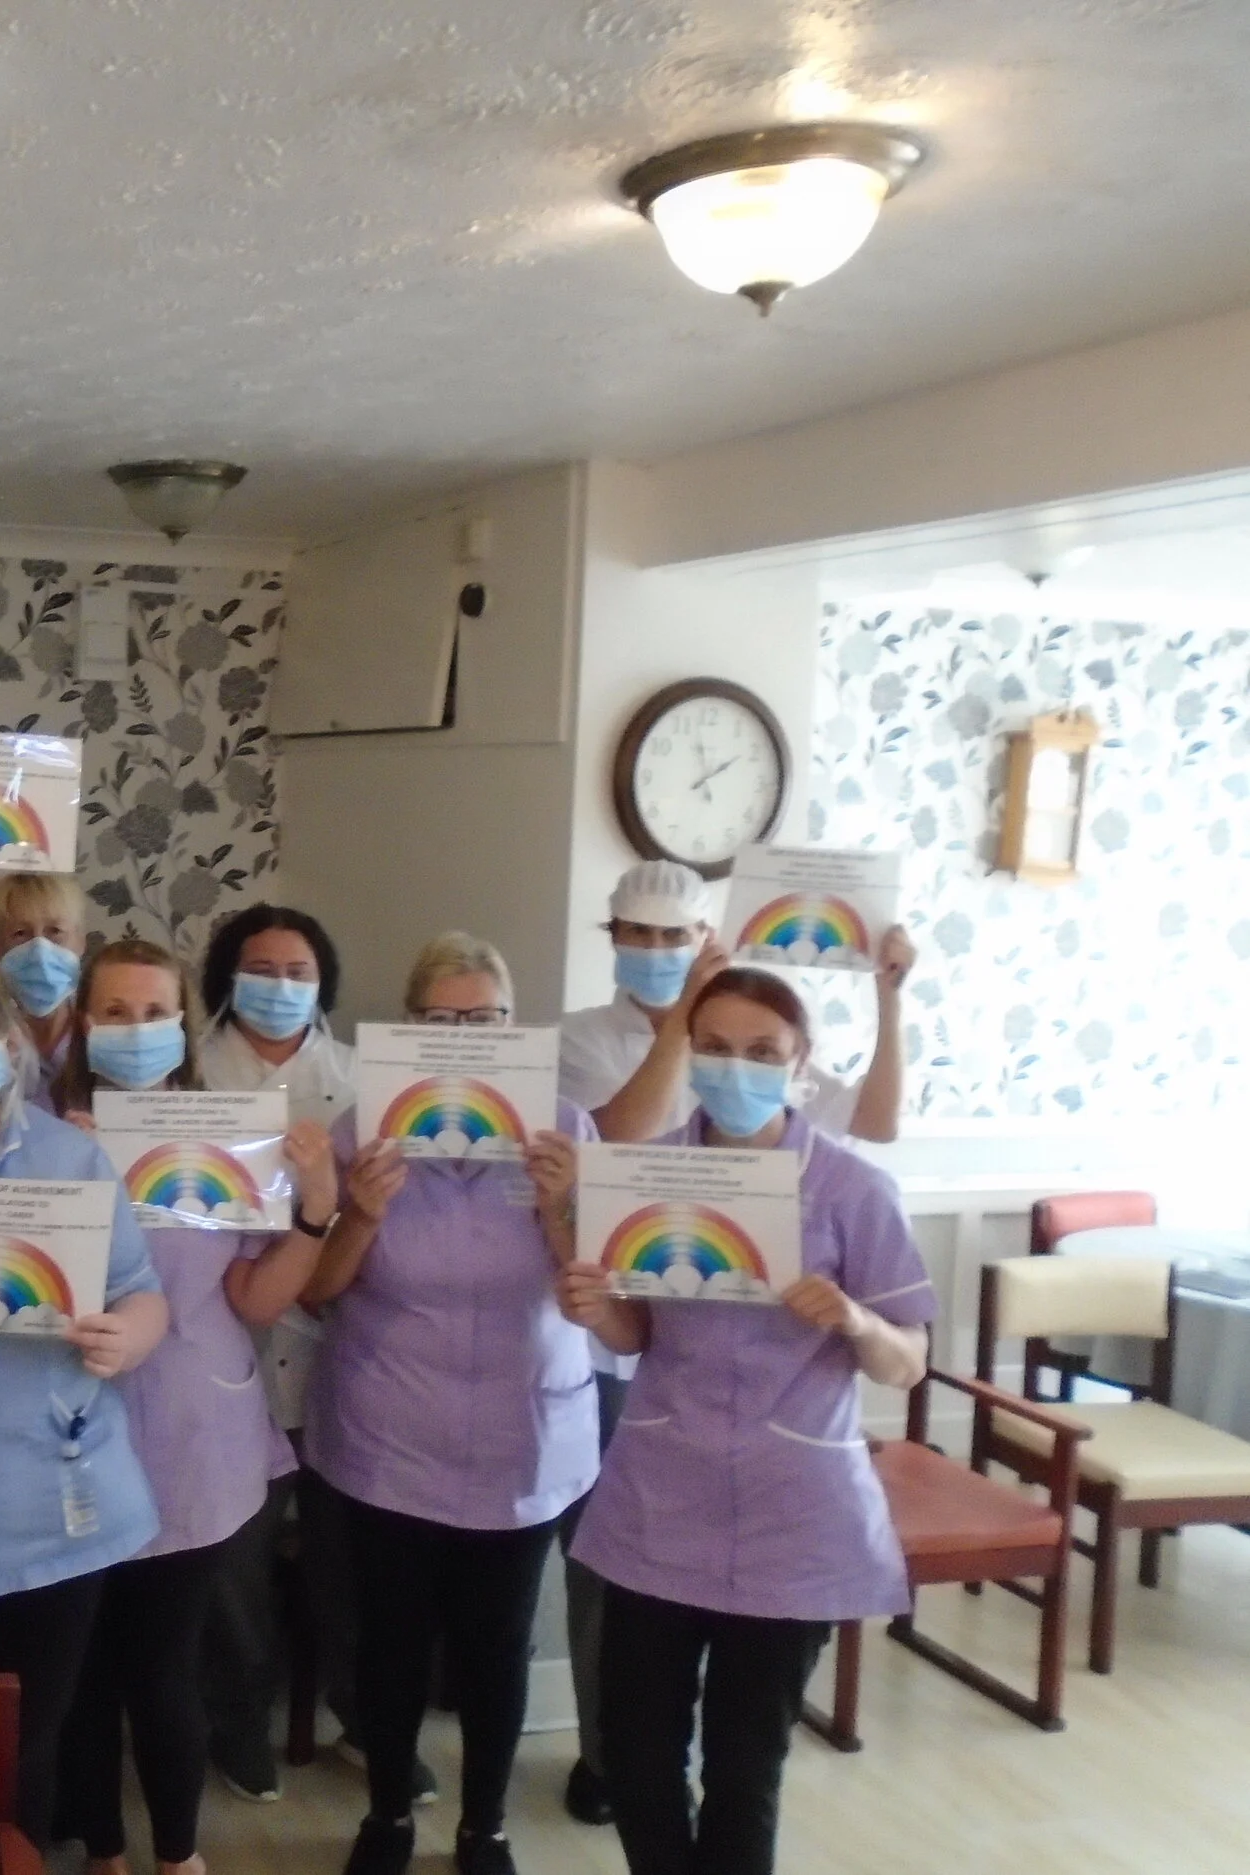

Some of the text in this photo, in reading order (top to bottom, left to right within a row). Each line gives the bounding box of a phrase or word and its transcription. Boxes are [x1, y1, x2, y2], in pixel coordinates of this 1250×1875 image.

[698, 707, 719, 725] 12
[672, 716, 691, 735] 11
[651, 737, 673, 756] 10
[13, 1186, 83, 1196] ACHIEVEMENT
